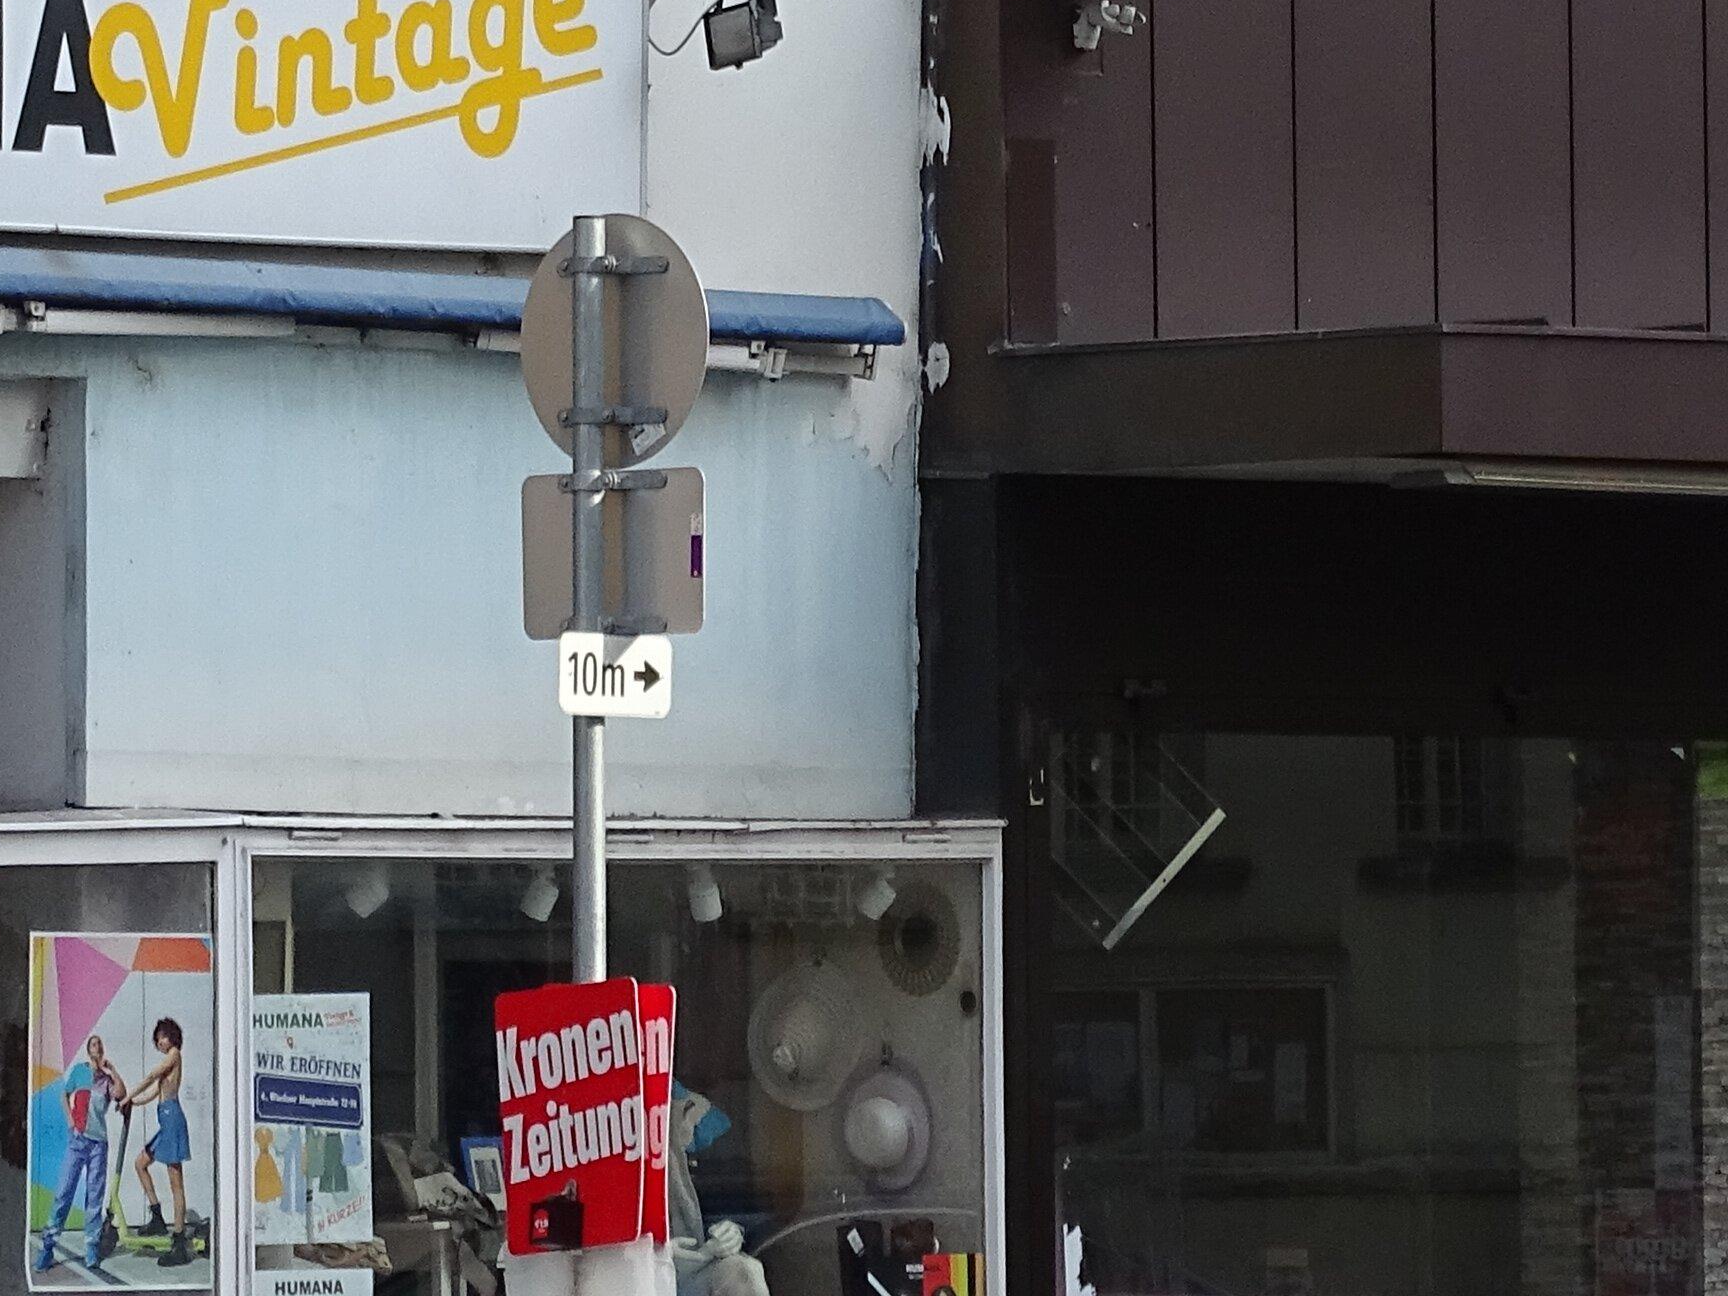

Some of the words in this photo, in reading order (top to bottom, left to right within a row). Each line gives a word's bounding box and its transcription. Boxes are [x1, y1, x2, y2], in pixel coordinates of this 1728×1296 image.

[568, 651, 624, 697] 10m
[252, 1012, 324, 1029] HUMANA
[256, 1051, 284, 1071] WIR
[290, 1055, 361, 1079] ERÖFFNEN
[495, 1009, 639, 1103] Kronen
[503, 1094, 642, 1185] Zeitung
[274, 1279, 344, 1296] HUMANA
